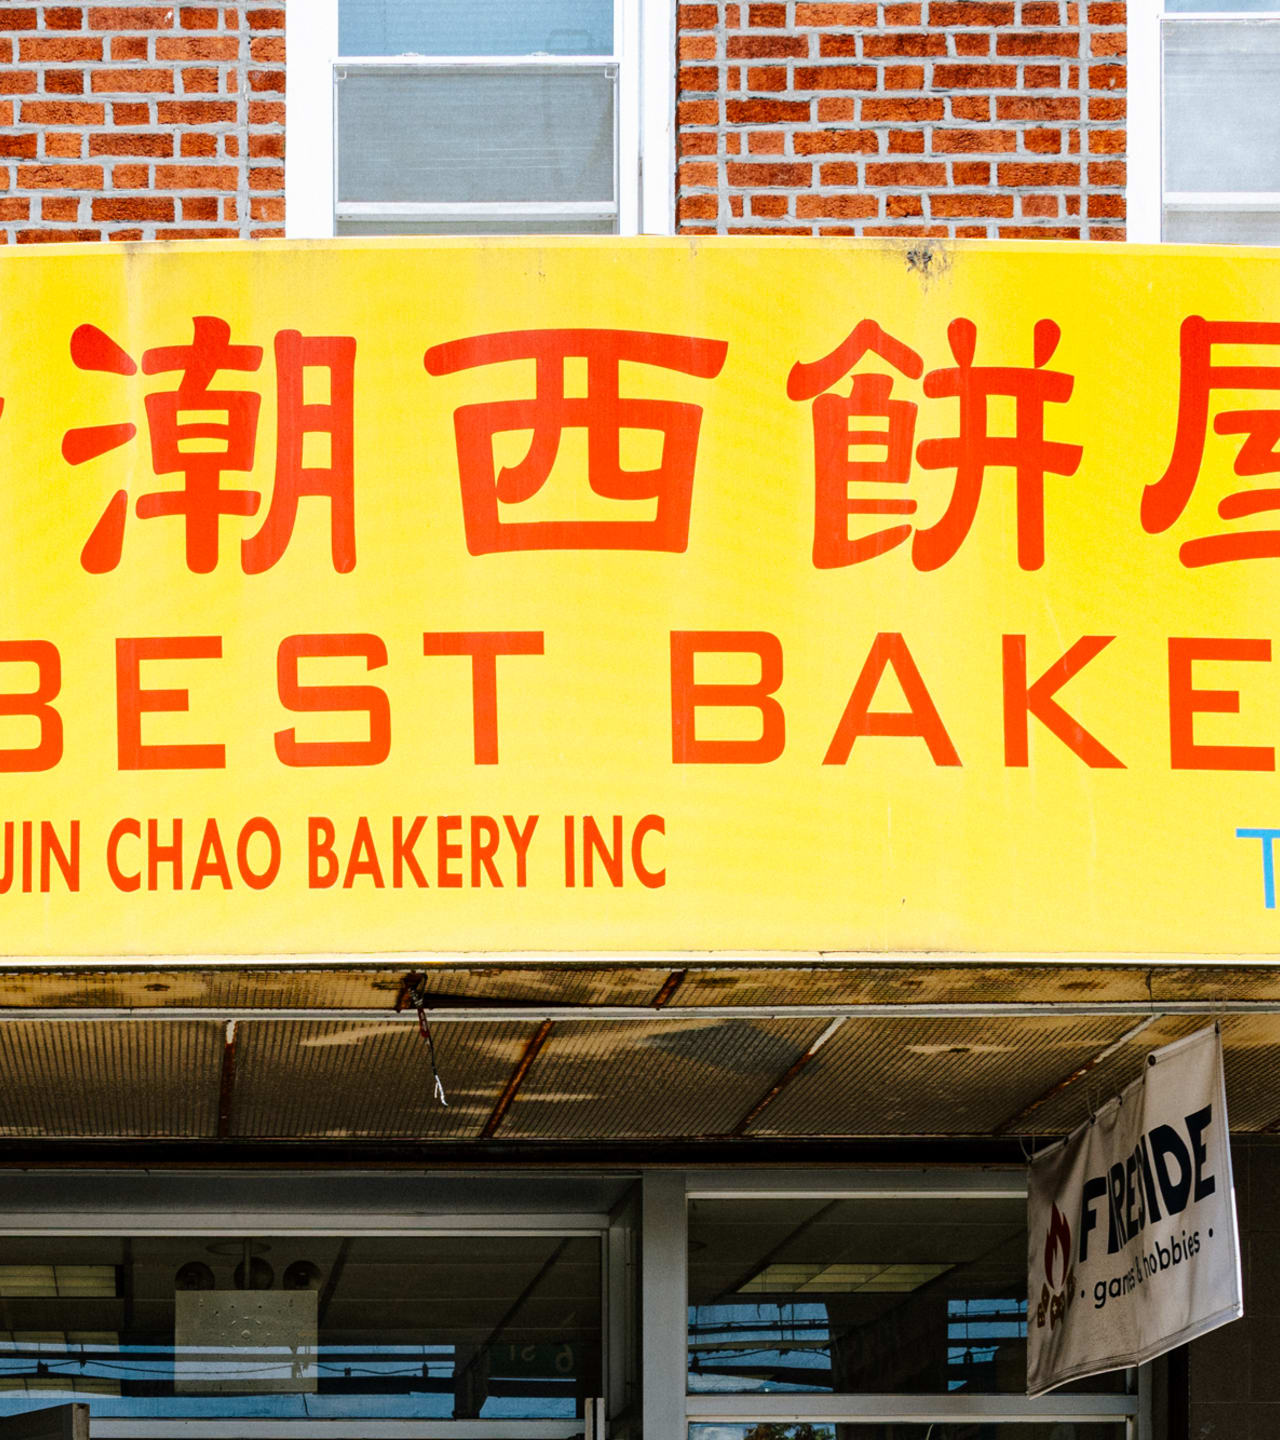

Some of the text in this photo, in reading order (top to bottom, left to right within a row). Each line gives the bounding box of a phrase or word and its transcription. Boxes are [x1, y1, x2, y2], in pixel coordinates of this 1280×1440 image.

[106, 816, 282, 893] CHAO
[307, 815, 538, 891] BAKERY
[564, 814, 667, 891] INC
